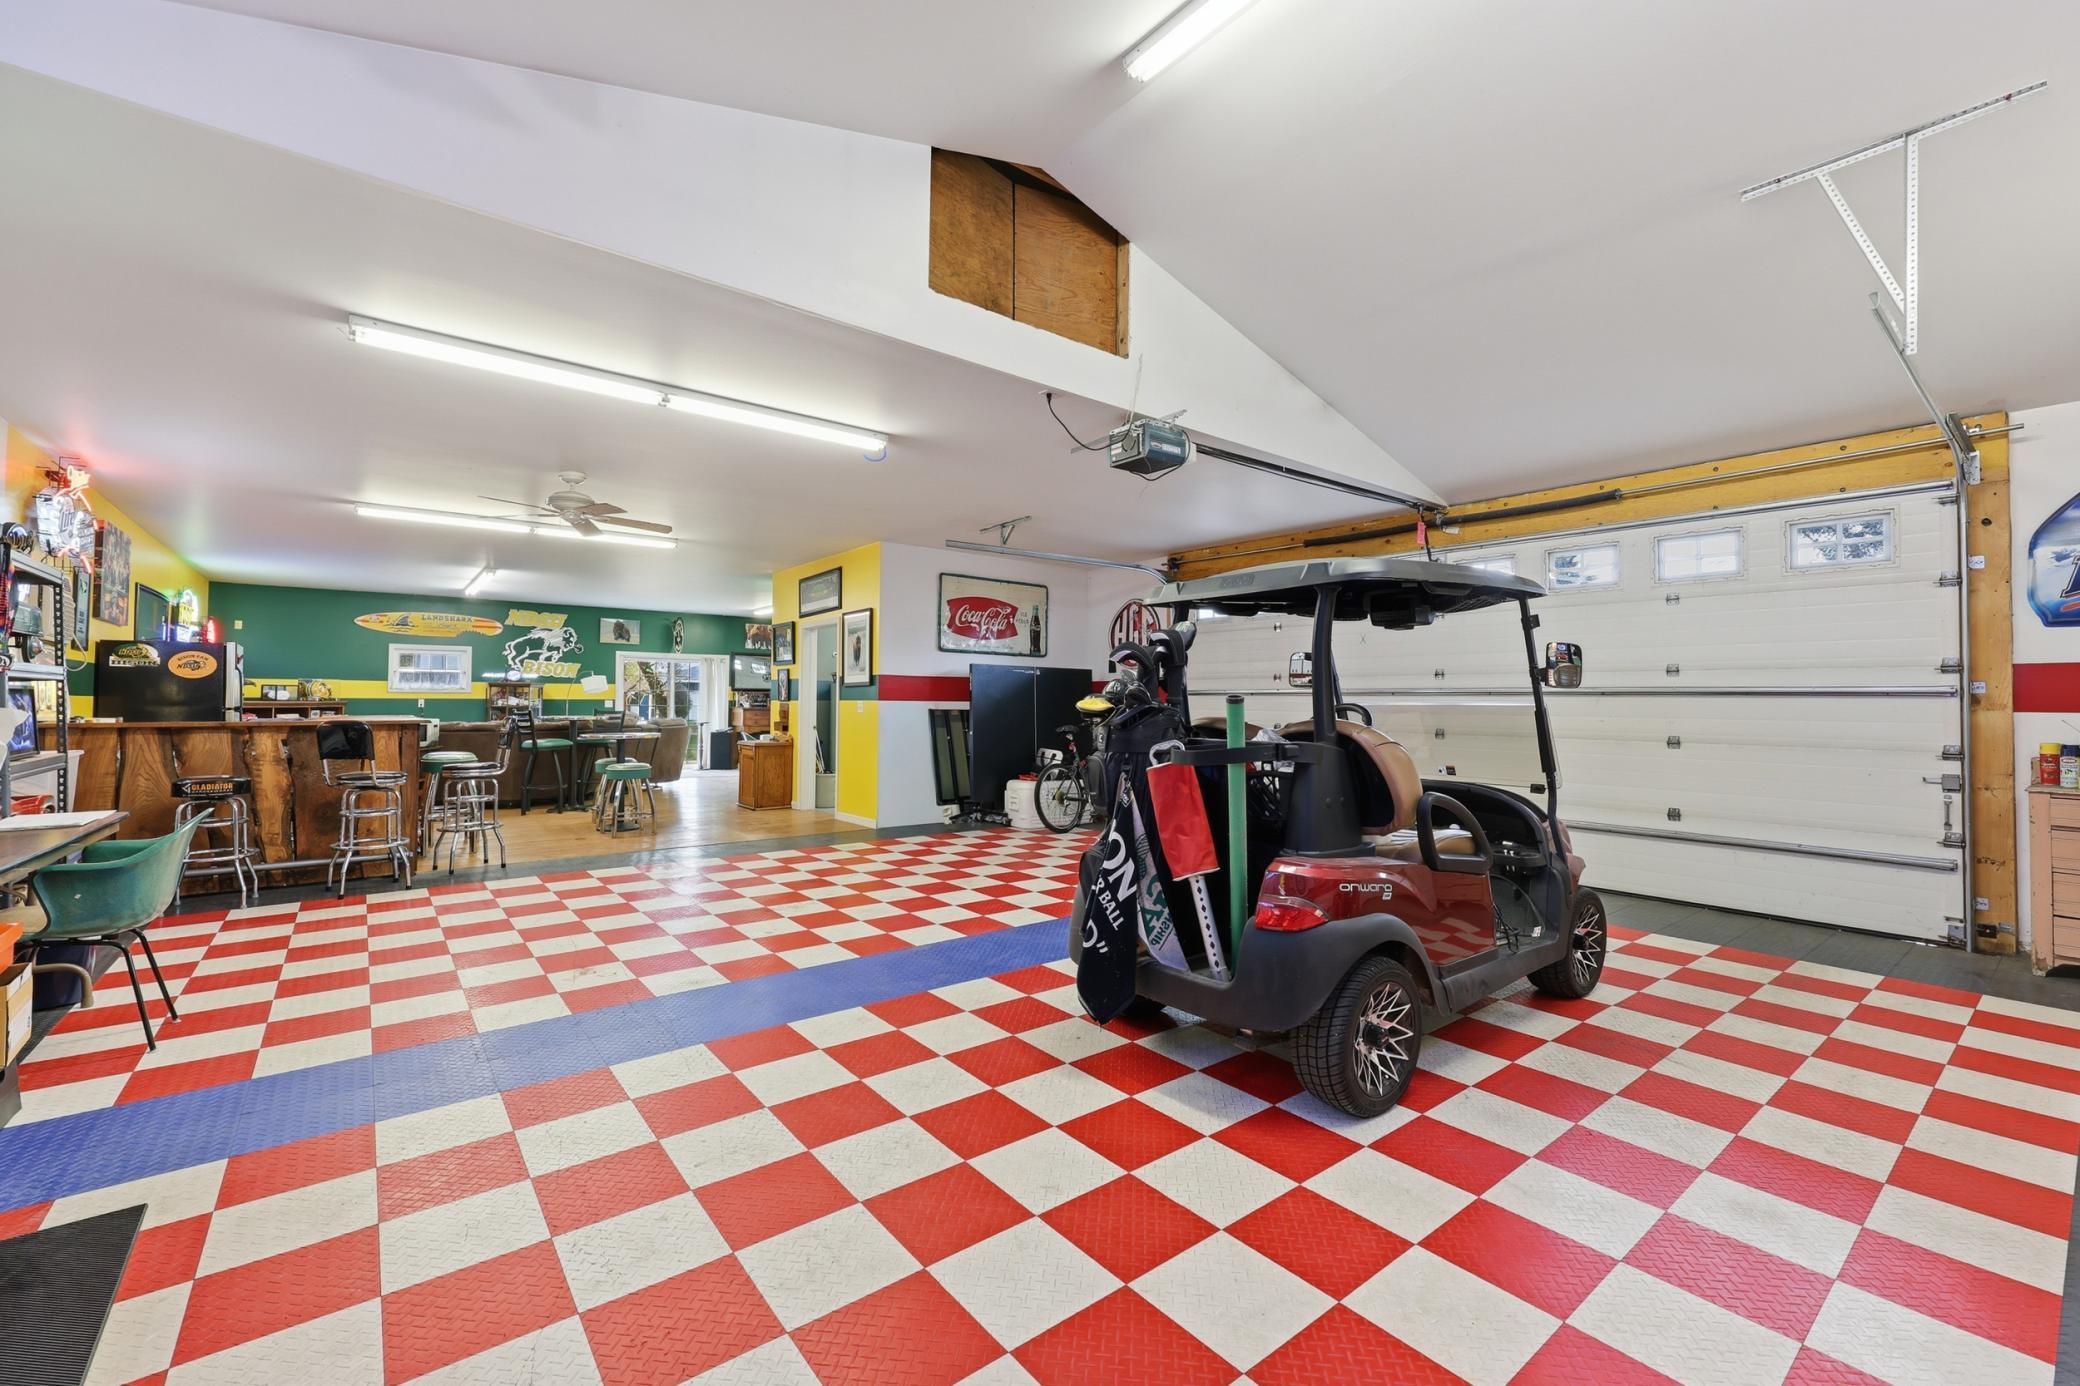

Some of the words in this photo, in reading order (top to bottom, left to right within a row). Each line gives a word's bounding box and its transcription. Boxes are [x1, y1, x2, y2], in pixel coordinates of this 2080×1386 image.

[522, 659, 581, 678] BISON
[191, 782, 233, 791] GLADIATOR
[1098, 890, 1126, 931] BALL
